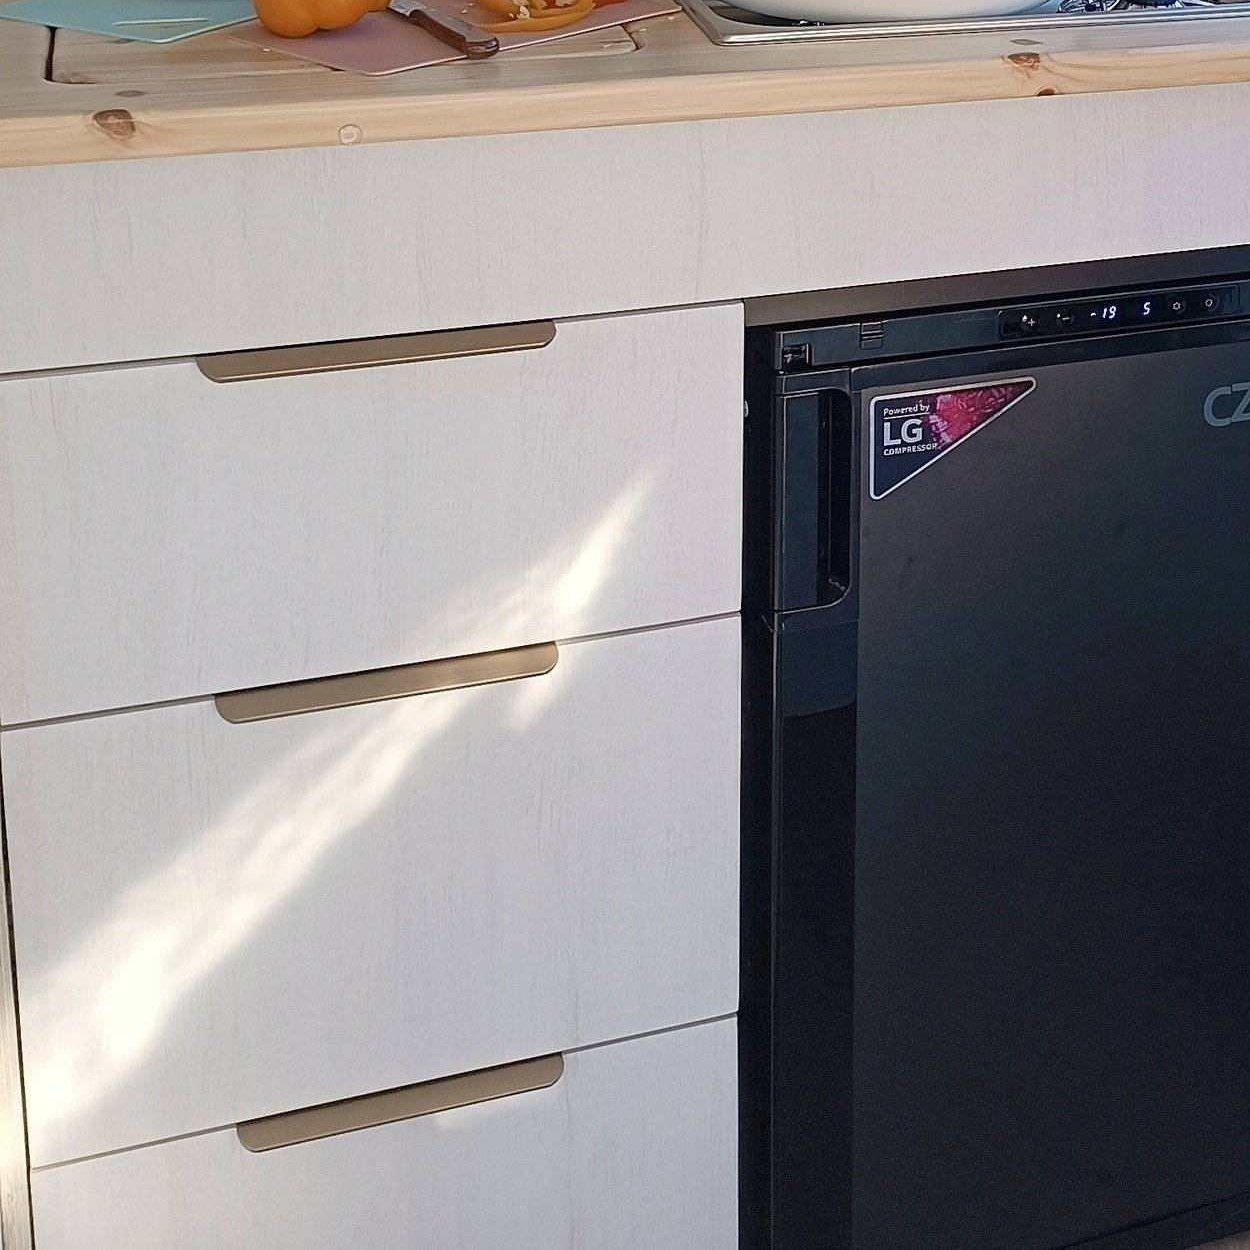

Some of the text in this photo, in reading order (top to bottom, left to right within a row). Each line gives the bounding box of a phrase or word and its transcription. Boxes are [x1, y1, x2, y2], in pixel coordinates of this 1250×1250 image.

[883, 402, 930, 417] Powered by
[883, 418, 923, 447] LG
[883, 442, 940, 456] COMPRESSOR
